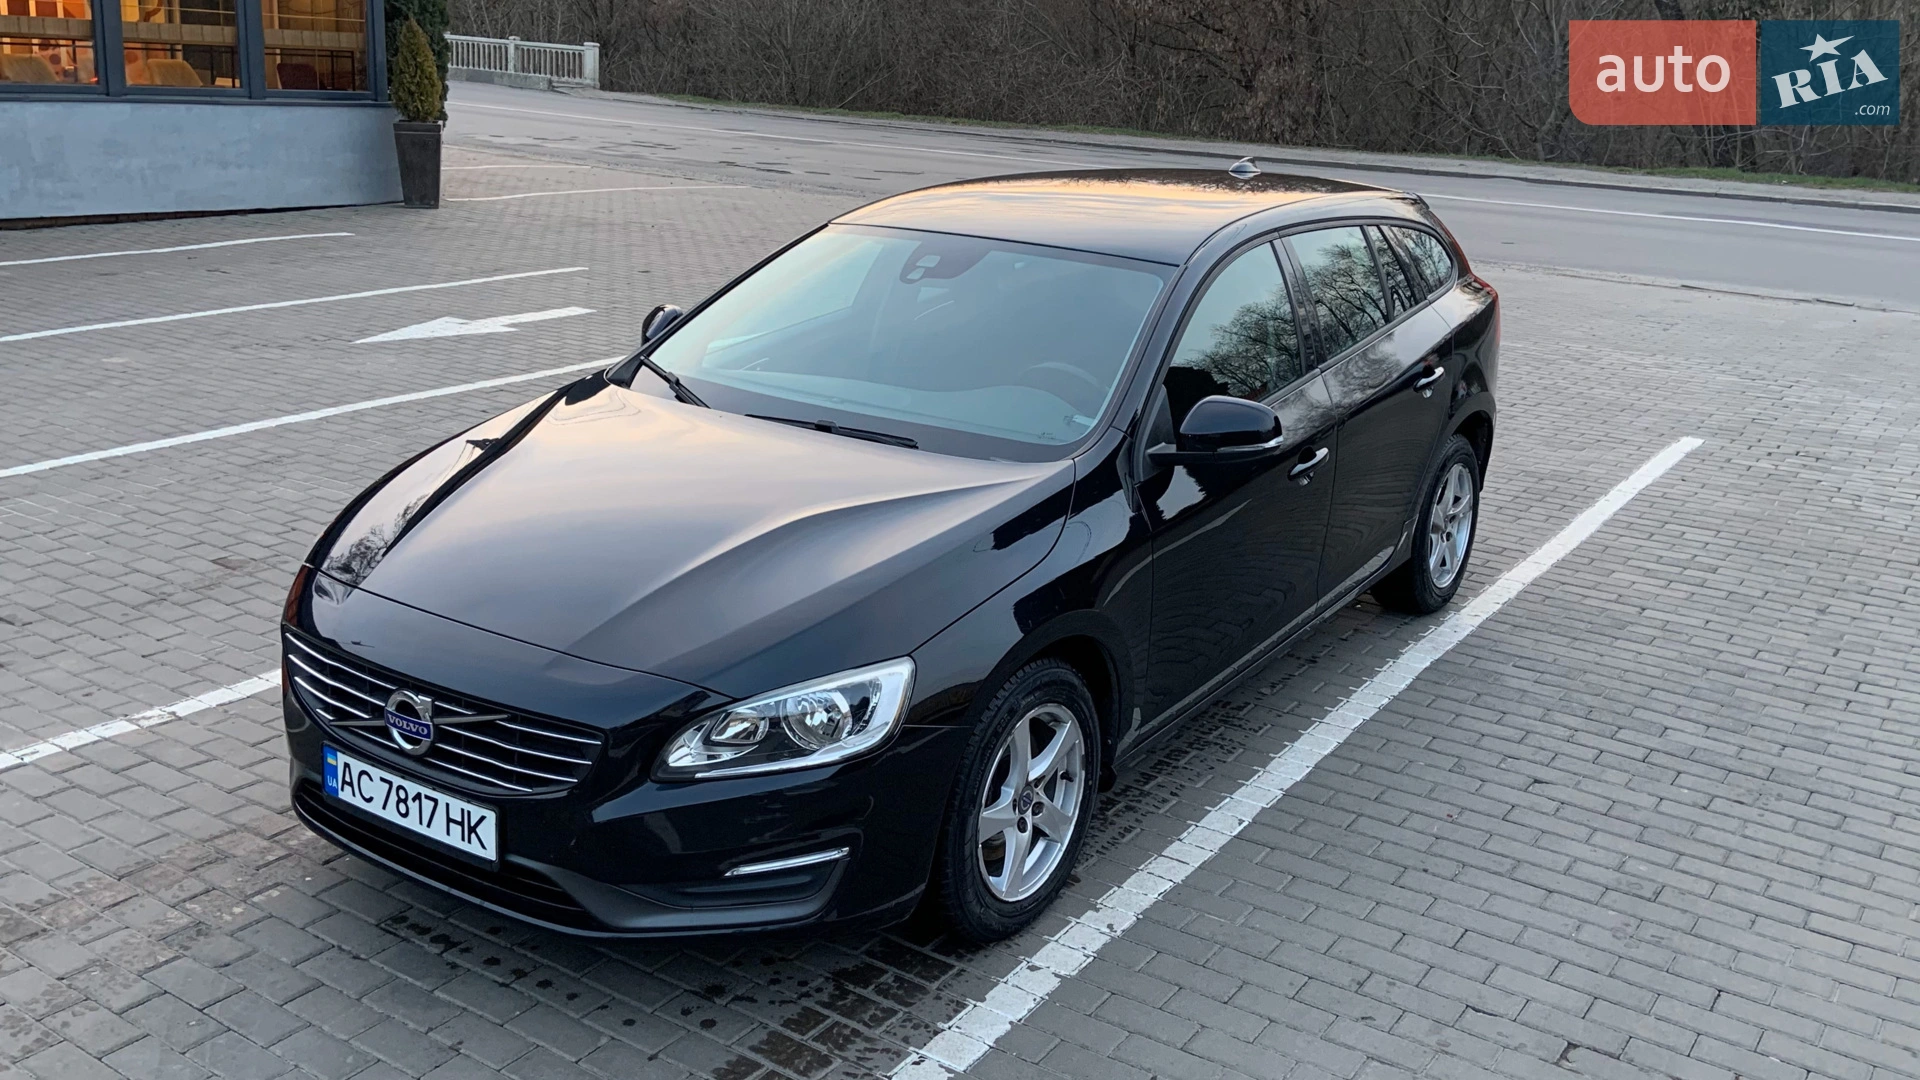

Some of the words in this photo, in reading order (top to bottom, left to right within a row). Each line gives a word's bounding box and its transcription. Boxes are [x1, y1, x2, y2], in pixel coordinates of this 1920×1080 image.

[387, 714, 428, 735] VOLVO
[327, 775, 338, 789] UA
[341, 762, 374, 803] AC
[380, 778, 438, 828] 7817
[446, 803, 487, 850] HK
